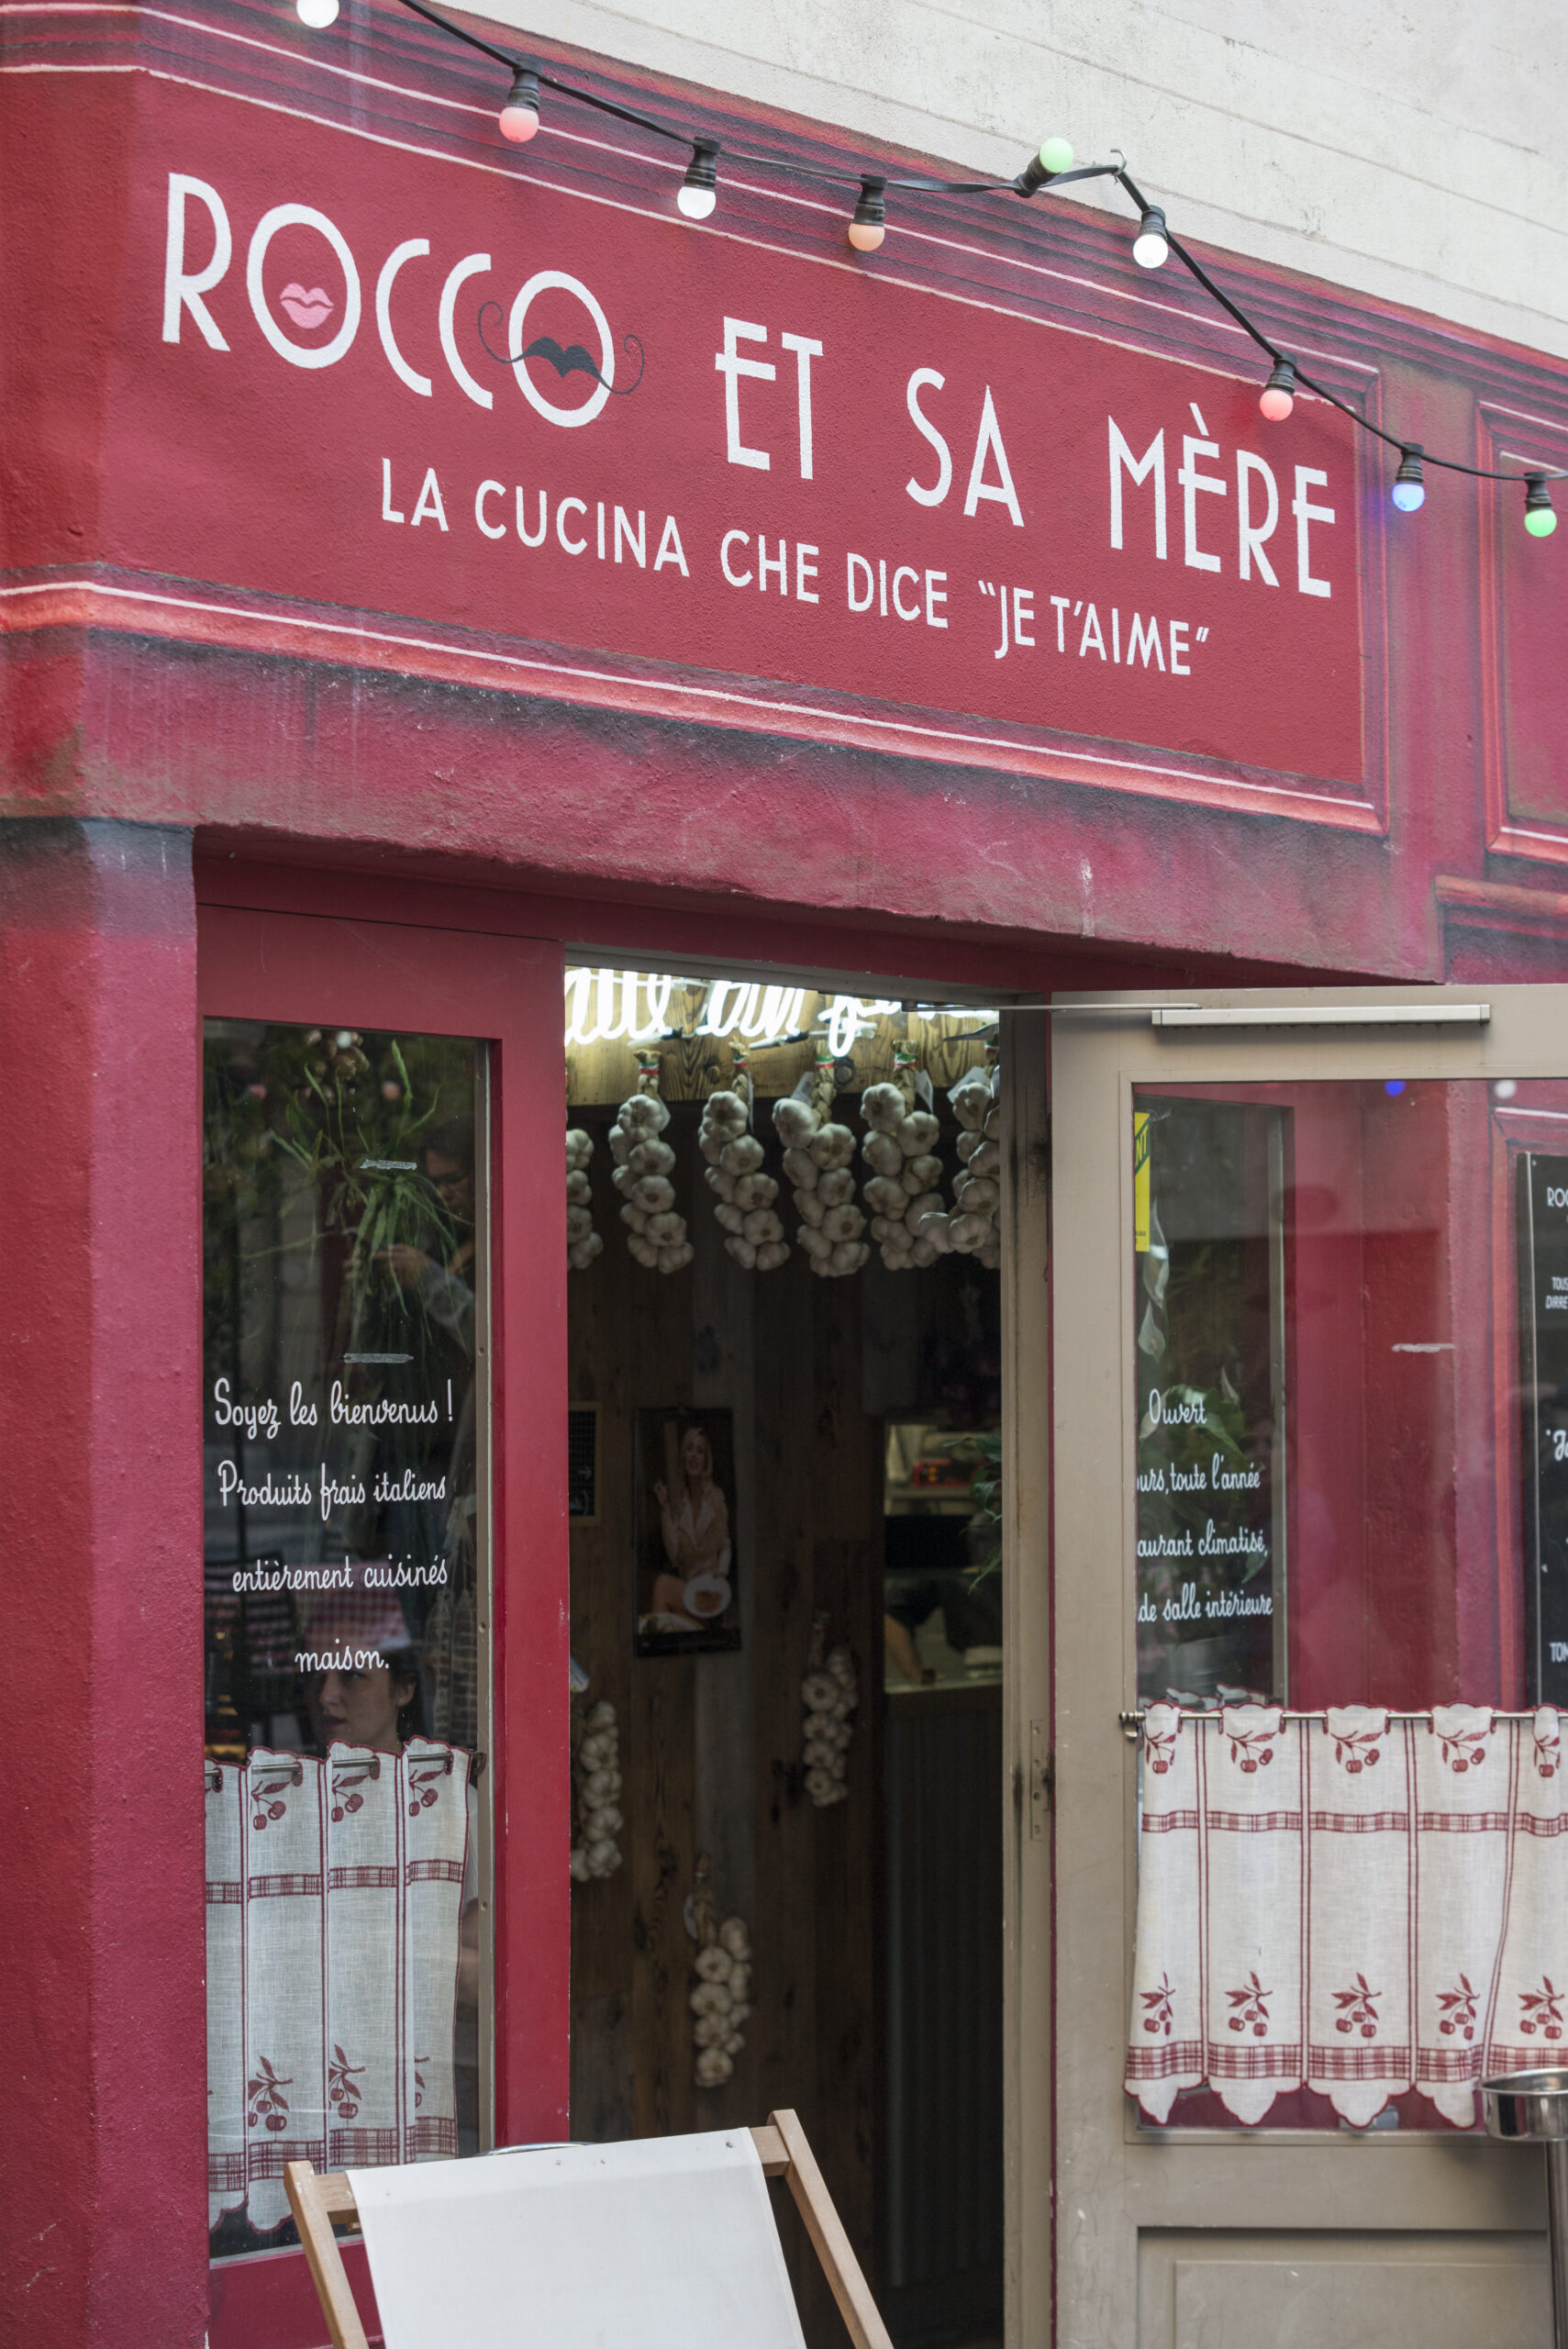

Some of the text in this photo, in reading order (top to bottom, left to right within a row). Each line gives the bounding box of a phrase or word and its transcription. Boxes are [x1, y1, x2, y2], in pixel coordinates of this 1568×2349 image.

[162, 173, 1332, 598] ROCCO ET SA MÈRE
[383, 459, 449, 530] LA
[475, 480, 689, 576] CUCINA
[721, 530, 818, 604] CHE
[848, 552, 948, 628] DICE
[1547, 1186, 1568, 1208] RO
[215, 1378, 281, 1440] Soyez
[291, 1381, 317, 1425] les
[331, 1381, 438, 1424] bienvenus
[1149, 1388, 1207, 1424] Ouvert
[218, 1460, 445, 1520] Produits frais italiens
[1170, 1463, 1207, 1492] toute
[1137, 1519, 1269, 1557] aurant climatisé,
[233, 1554, 447, 1592] entièrement cuisinés
[1138, 1582, 1273, 1622] de salle intérieure
[295, 1639, 389, 1672] maison.
